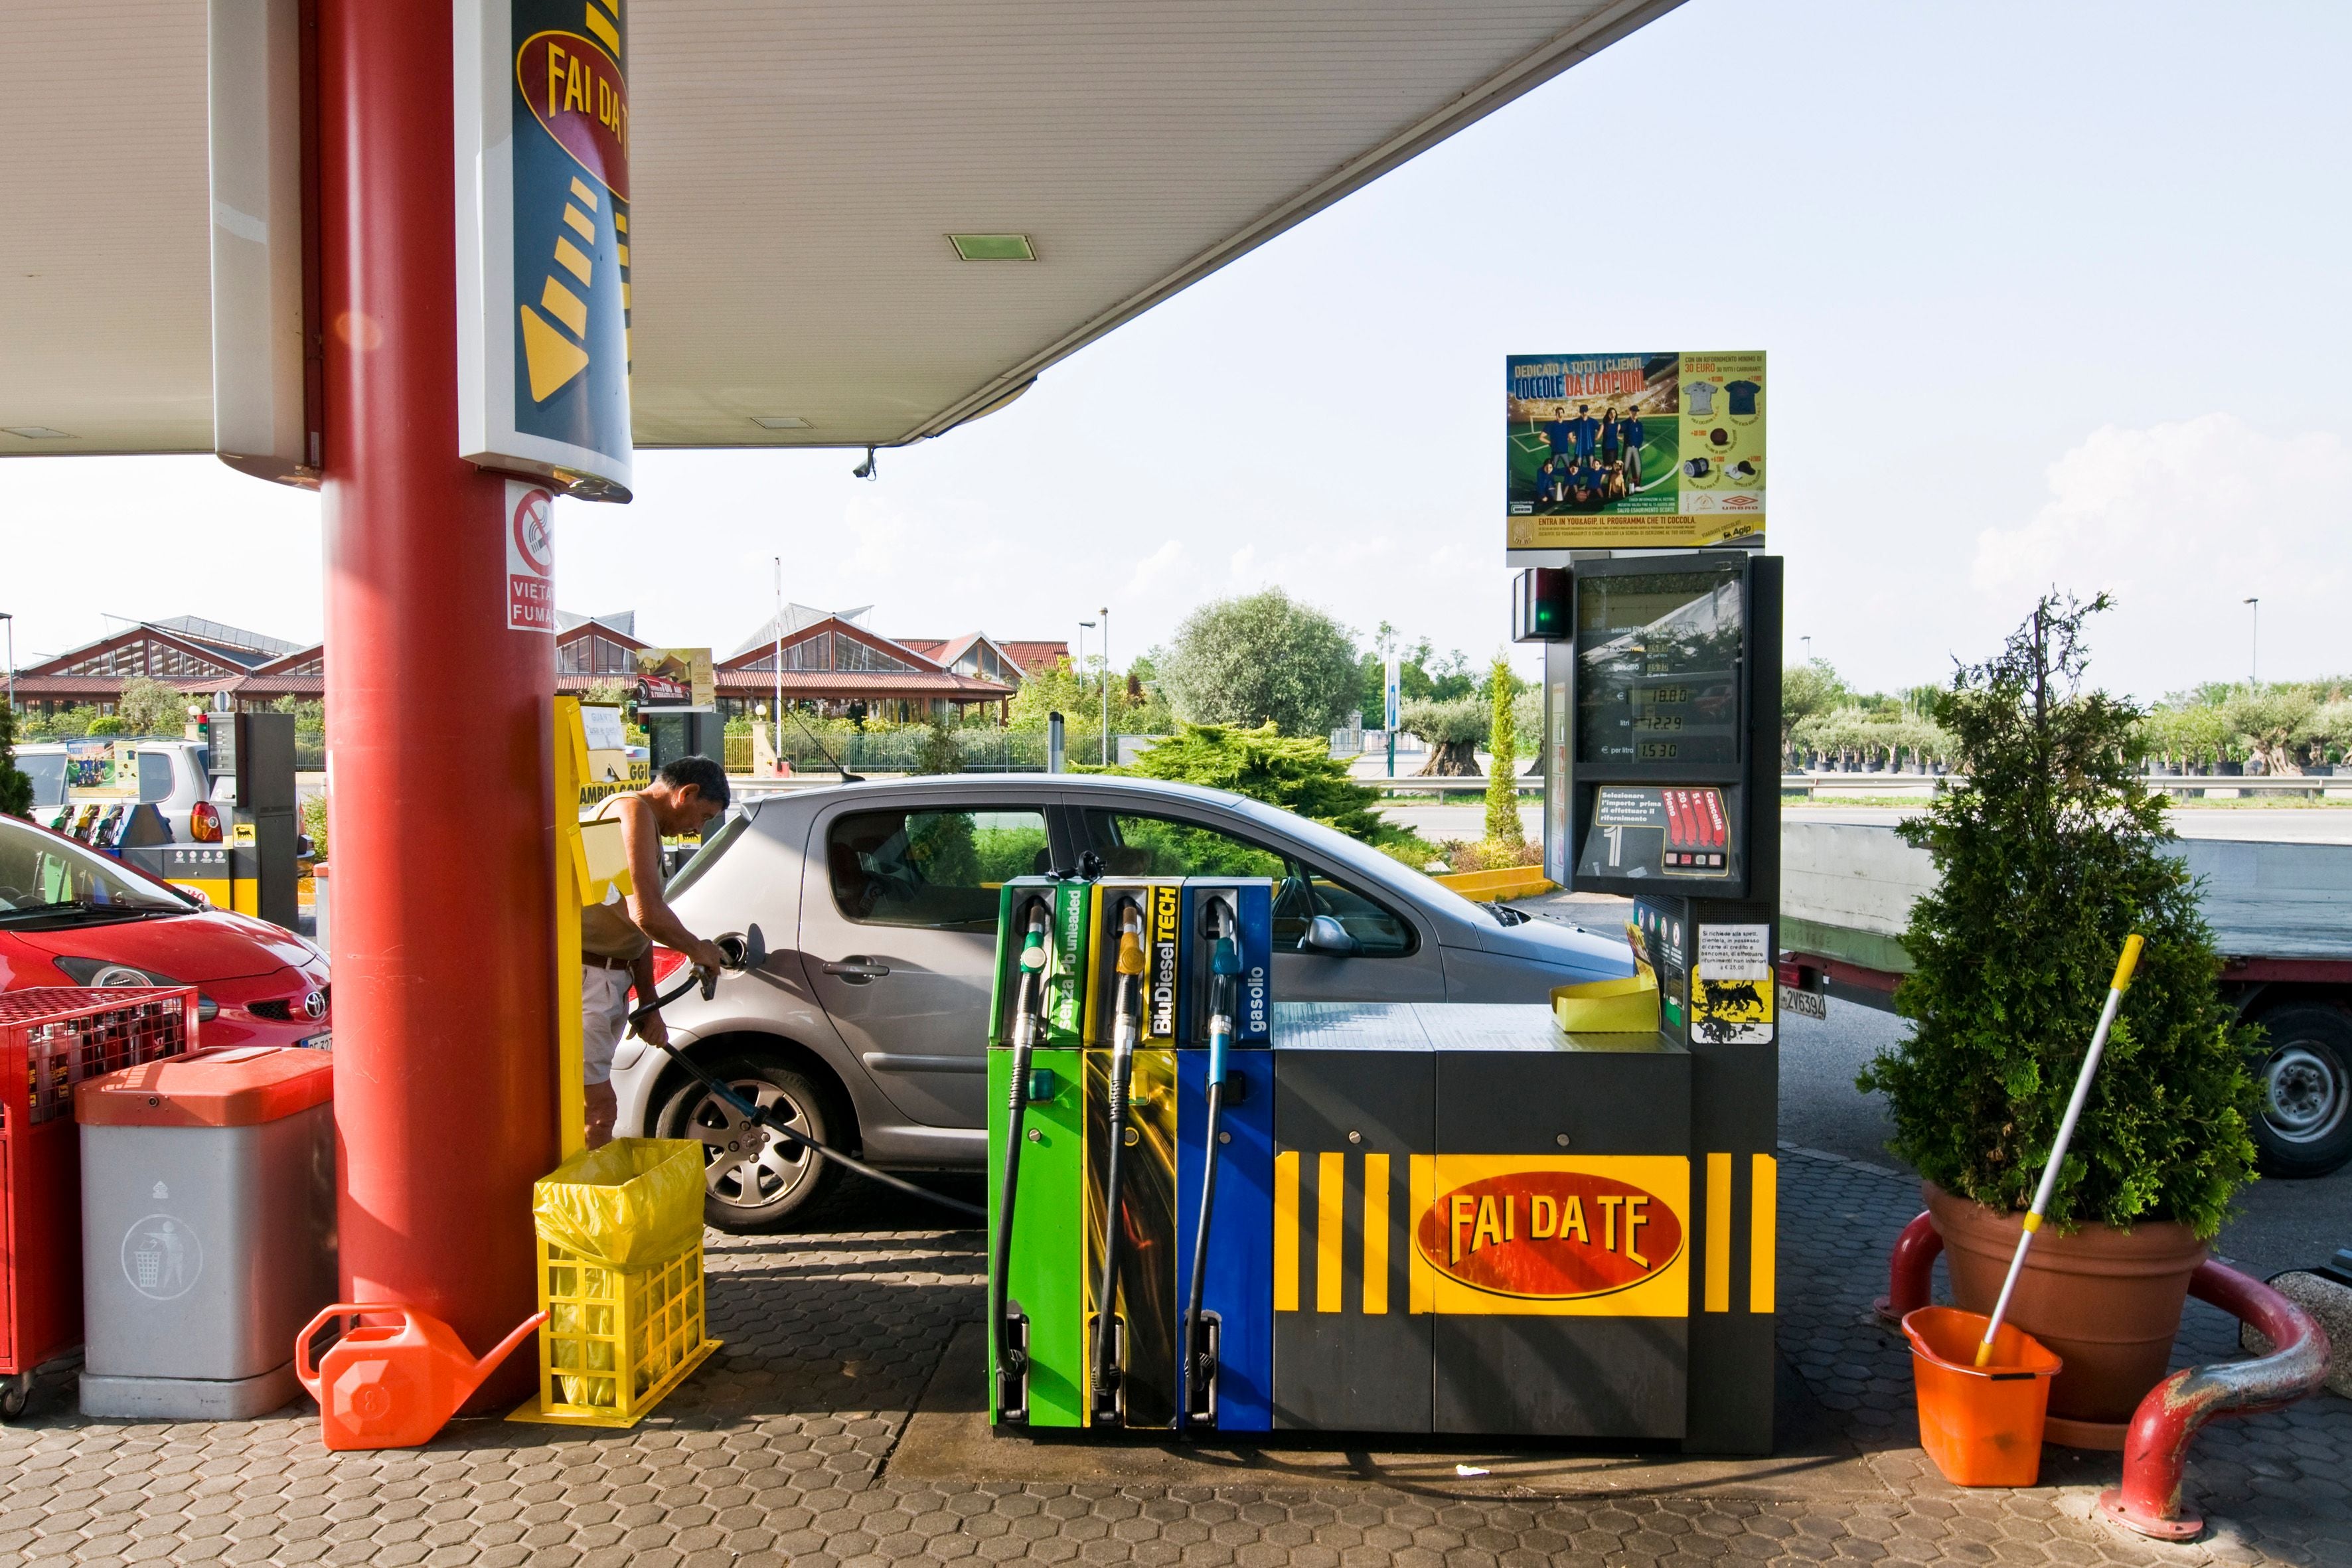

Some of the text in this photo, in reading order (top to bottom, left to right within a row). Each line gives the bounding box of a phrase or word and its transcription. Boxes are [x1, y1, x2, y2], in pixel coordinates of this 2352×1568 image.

[548, 42, 591, 118] FAI
[599, 76, 621, 144] DA
[1515, 363, 1559, 377] DEDICATO
[1562, 362, 1569, 374] A
[1571, 360, 1597, 373] TUTTI
[1600, 360, 1603, 371] I
[1685, 363, 1694, 372] 30
[1696, 363, 1715, 372] EURO
[1514, 376, 1563, 400] COCCOLE
[1565, 373, 1583, 396] DA
[1733, 525, 1751, 535] Agip
[513, 604, 555, 623] FUMA
[1653, 689, 1687, 702] 18.80
[1648, 717, 1682, 730] 12.29
[1611, 748, 1621, 756] per
[1642, 744, 1677, 757] 1.530
[579, 785, 616, 804] AMBIO
[1664, 791, 1676, 817] Pieno
[1678, 791, 1687, 803] 20
[1706, 791, 1722, 831] Cancella
[1603, 824, 1623, 867] 1
[1059, 889, 1081, 1031] senza Pb unleaded
[1153, 887, 1176, 1035] BluDieselTECH
[1248, 967, 1266, 1032] gasolio
[1787, 991, 1824, 1015] 2V6394
[1703, 1024, 1737, 1042] Agip
[1449, 1194, 1651, 1270] FAI DA TE
